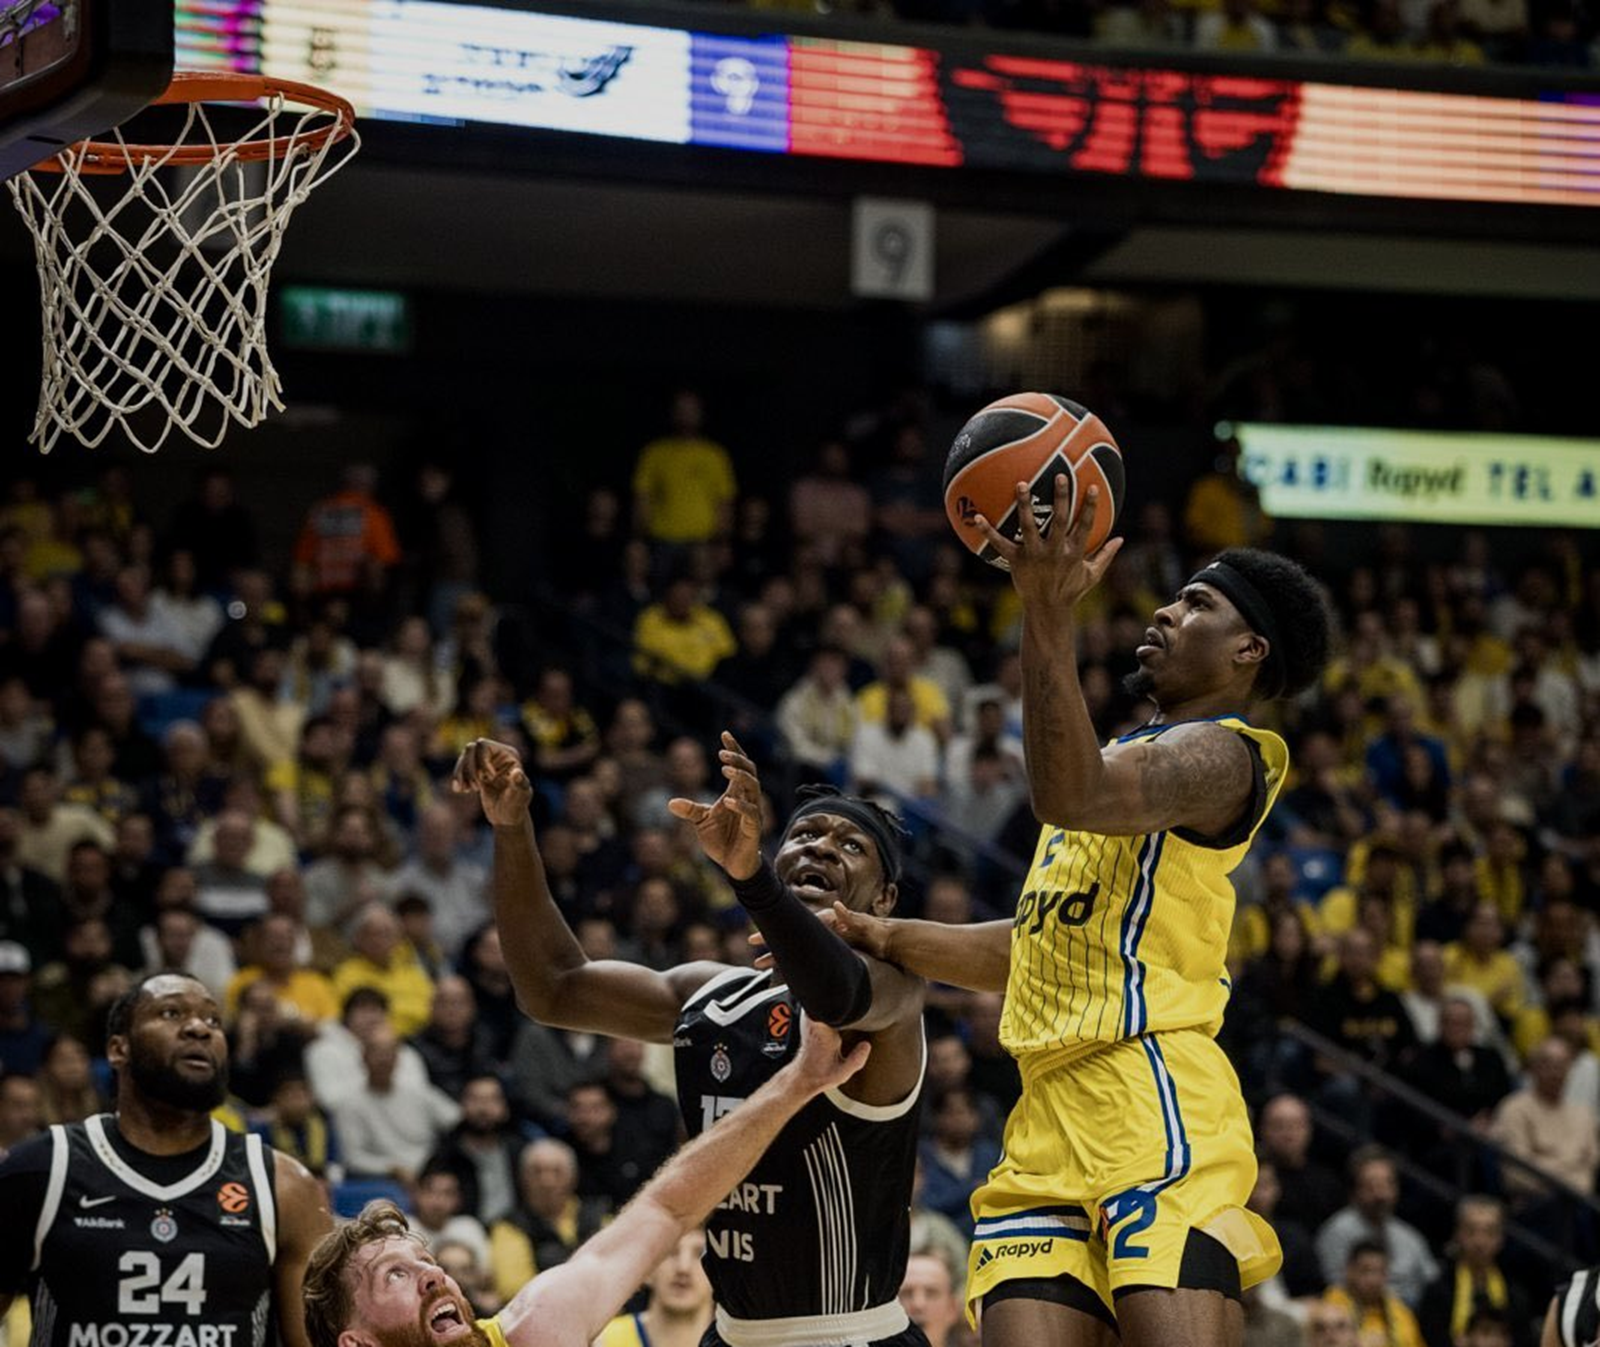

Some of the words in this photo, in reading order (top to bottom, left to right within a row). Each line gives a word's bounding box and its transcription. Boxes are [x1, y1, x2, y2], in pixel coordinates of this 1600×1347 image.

[868, 218, 914, 288] 9
[1489, 461, 1552, 501] TEL
[995, 1238, 1054, 1259] Rapyd
[1109, 1189, 1157, 1260] 2
[117, 1250, 207, 1316] 24
[69, 1321, 237, 1347] MOZZART
